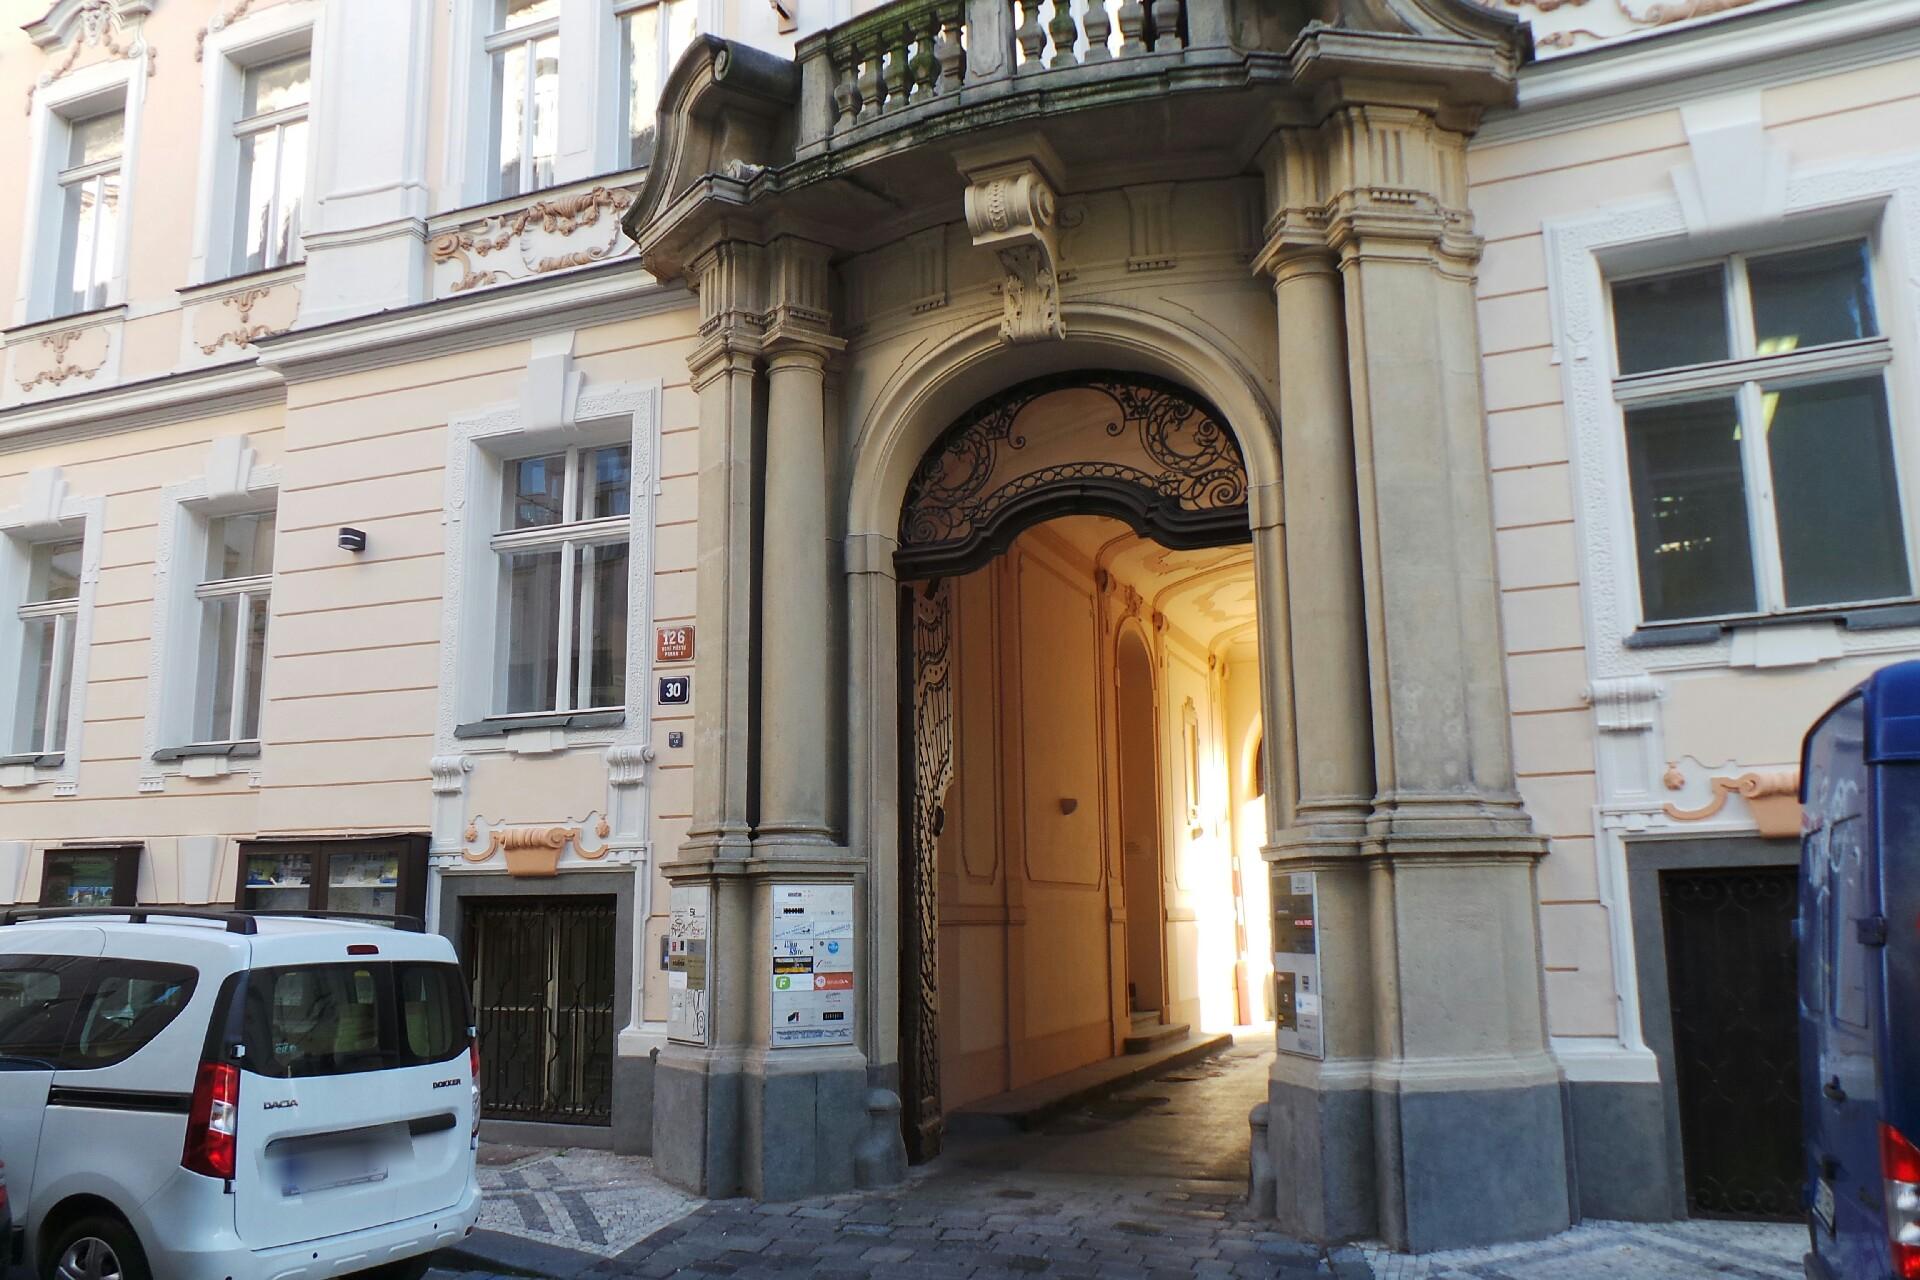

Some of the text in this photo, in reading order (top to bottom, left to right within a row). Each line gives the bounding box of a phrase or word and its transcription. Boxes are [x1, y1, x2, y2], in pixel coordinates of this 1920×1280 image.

[663, 630, 685, 645] 126
[665, 682, 681, 697] 30
[432, 1078, 461, 1089] DOKKER
[263, 1099, 298, 1110] DACIA
